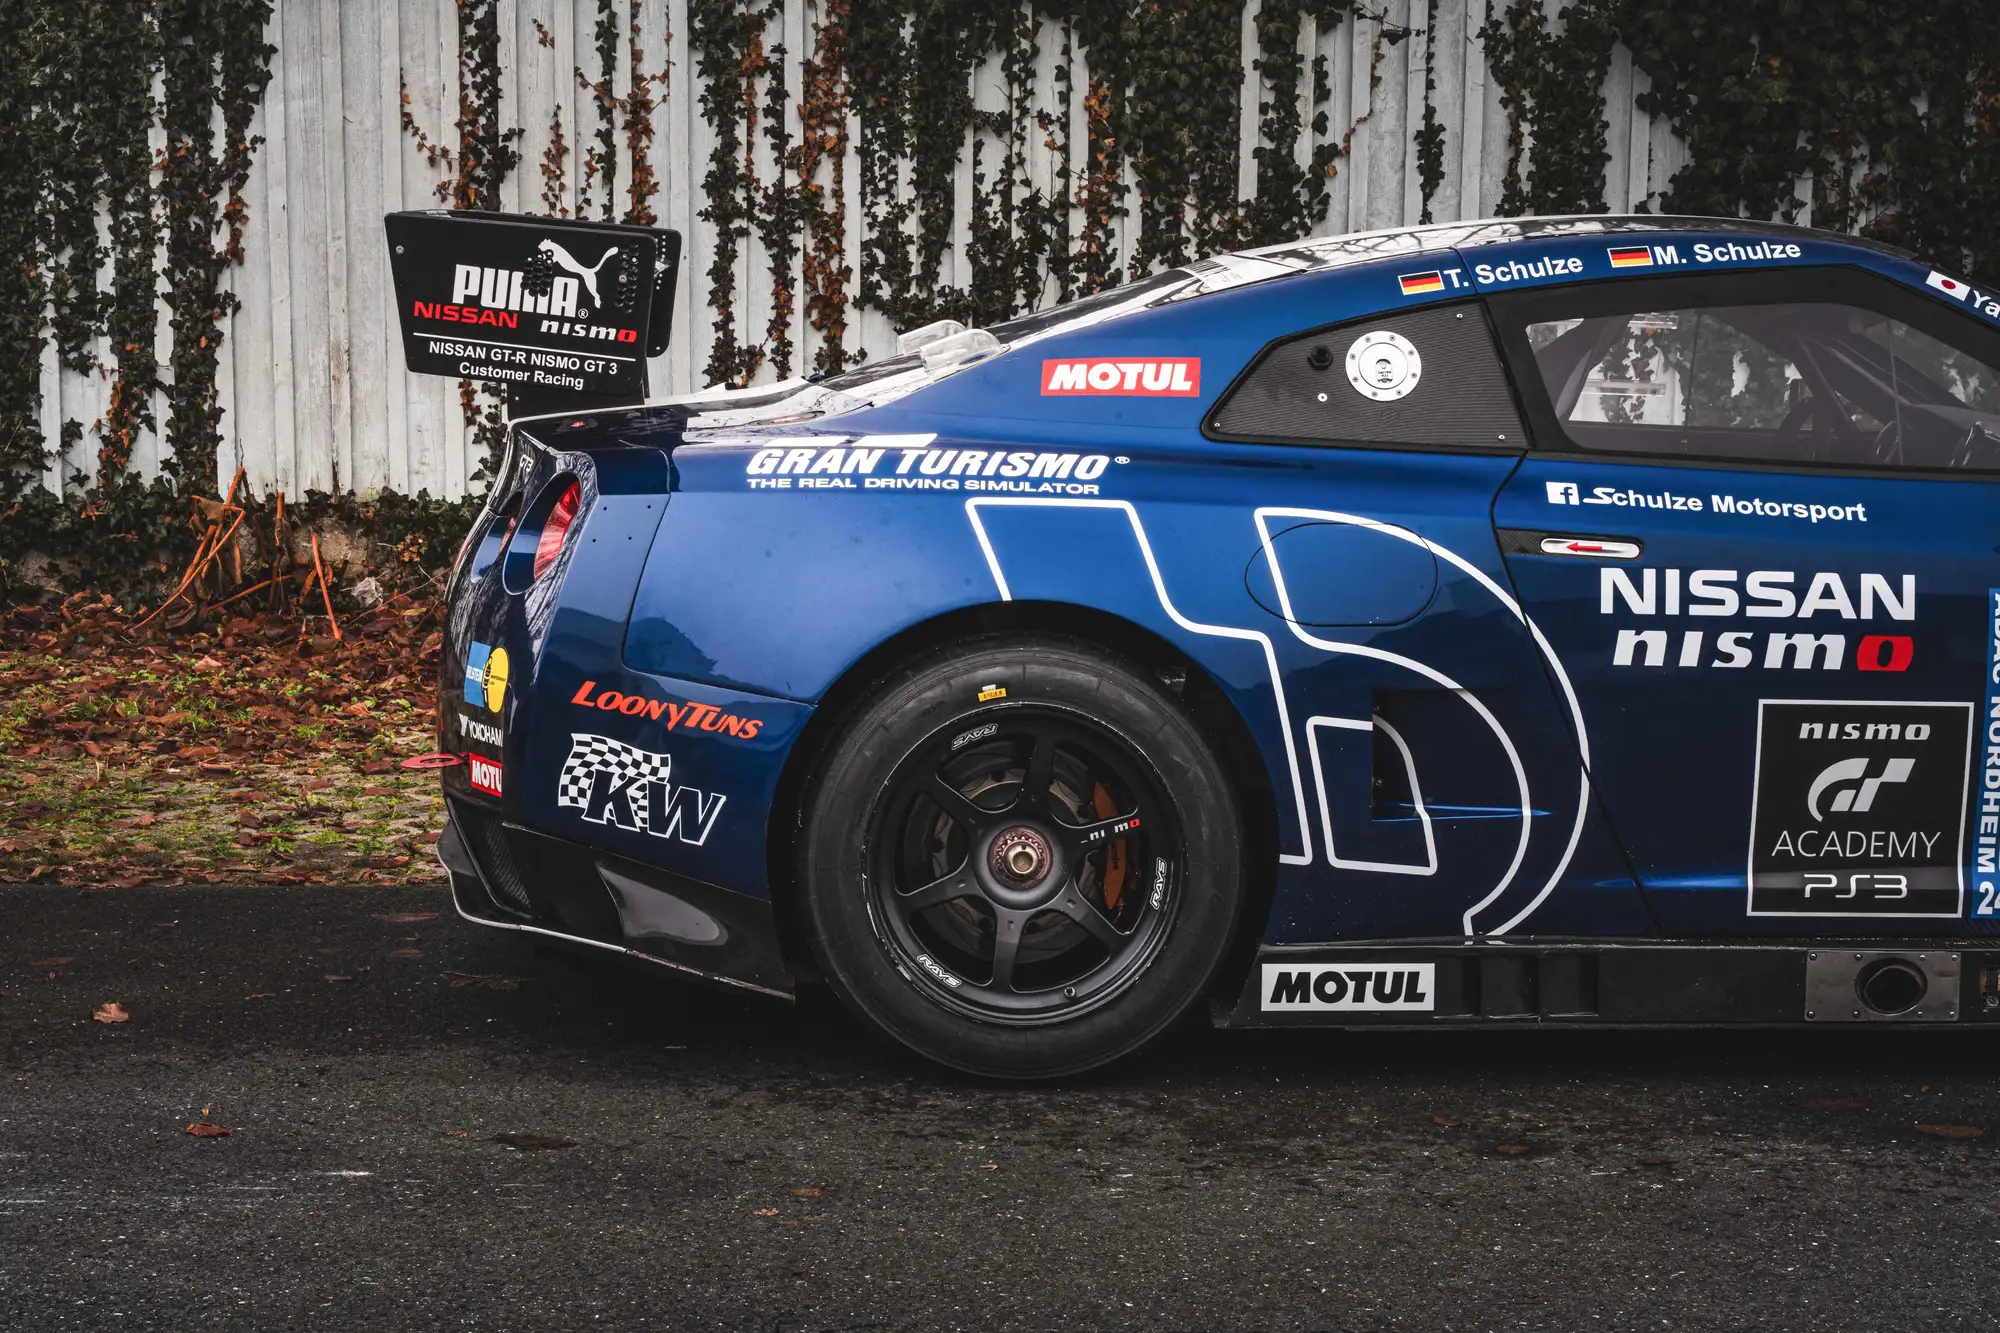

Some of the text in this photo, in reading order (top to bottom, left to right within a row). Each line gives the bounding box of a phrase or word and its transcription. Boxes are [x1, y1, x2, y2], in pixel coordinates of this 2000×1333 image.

[1653, 241, 1802, 265] M. Schulze
[1444, 256, 1584, 289] T. Schulze
[452, 264, 579, 318] PUMA
[1973, 289, 2000, 318] Ya
[413, 301, 518, 329] NISSAN
[540, 320, 637, 344] nismo
[429, 341, 618, 375] NISSAN GT-R NISMO GT 3
[459, 362, 585, 391] Customer Racing
[1047, 363, 1193, 392] MOTUL
[746, 448, 1110, 481] GRAN TURISMO
[746, 478, 1100, 495] THE REAL DRIVING SIMULATOR
[1583, 487, 1703, 512] Schulze
[1711, 494, 1868, 523] Motorsport
[1601, 567, 1916, 621] NISSAN
[1612, 629, 1914, 672] nismo
[1799, 722, 1931, 741] nismo
[581, 768, 727, 847] KW
[1771, 830, 1942, 859] ACADEMY
[1150, 857, 1167, 909] RAYS
[1804, 873, 1908, 899] PS3
[917, 954, 962, 987] RAYS
[1269, 971, 1427, 1004] MOTUL
